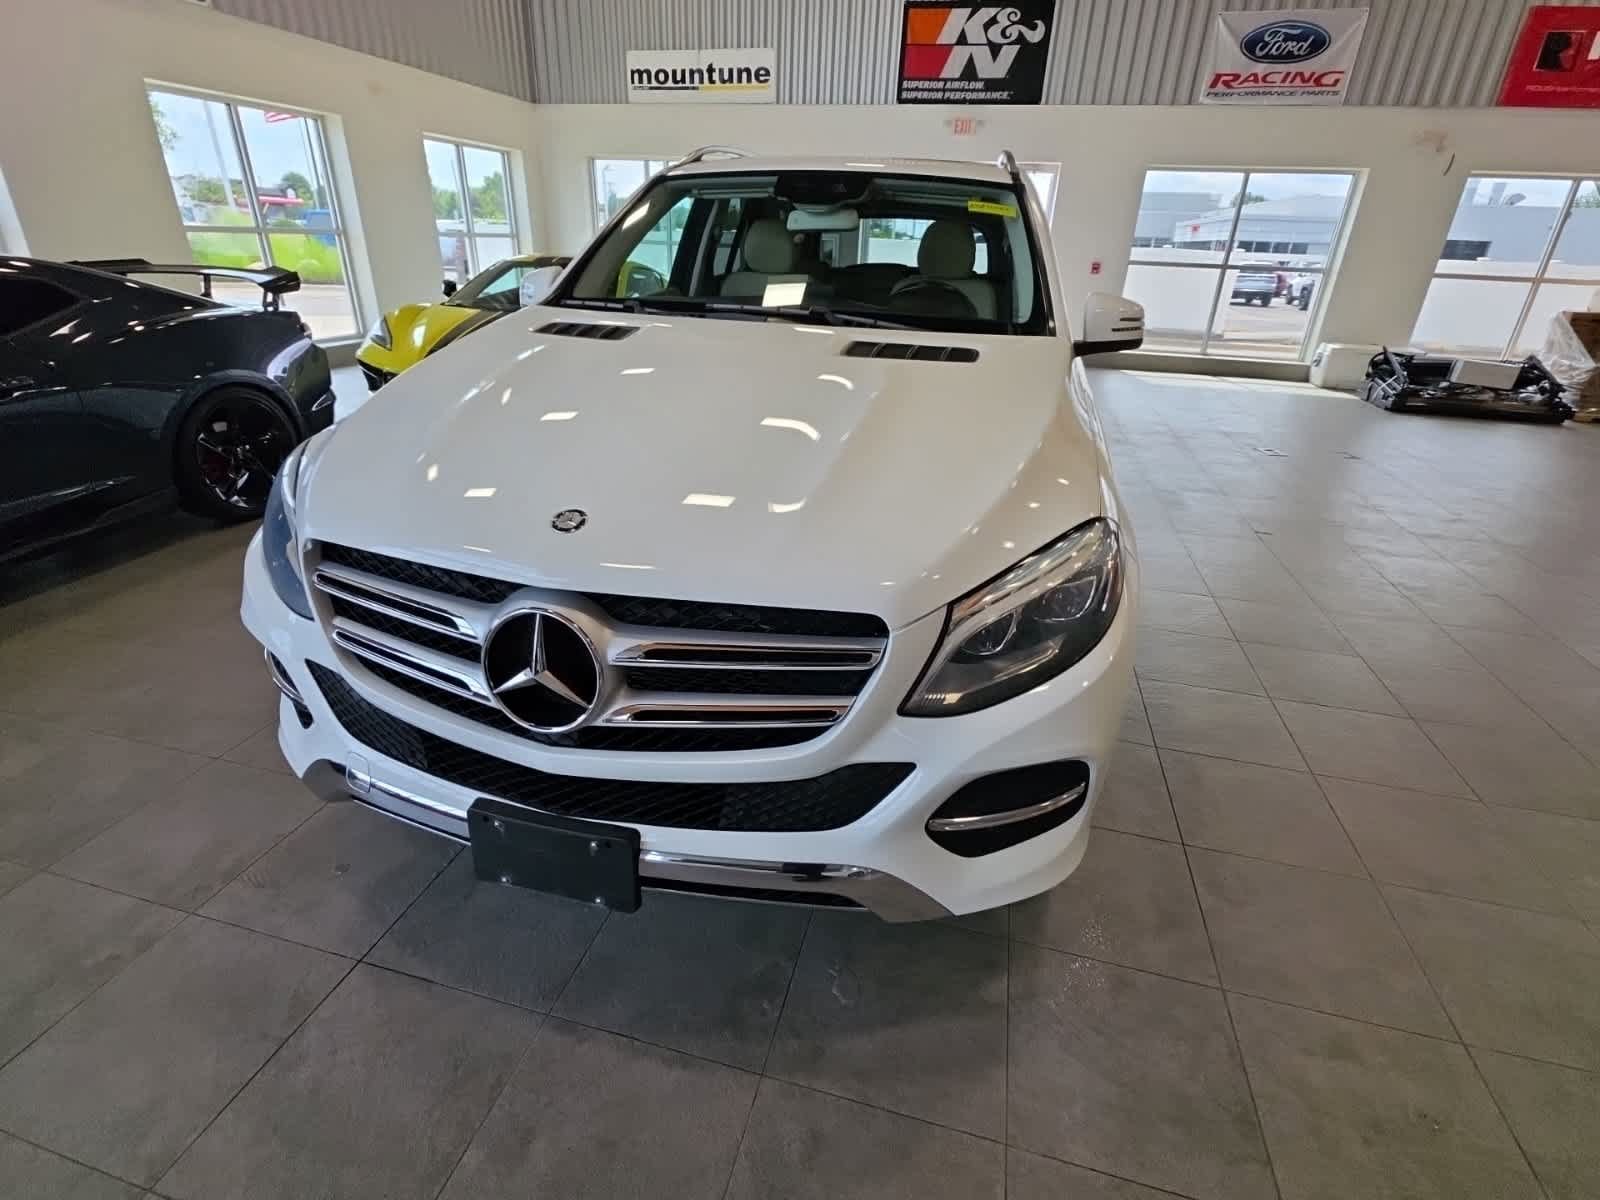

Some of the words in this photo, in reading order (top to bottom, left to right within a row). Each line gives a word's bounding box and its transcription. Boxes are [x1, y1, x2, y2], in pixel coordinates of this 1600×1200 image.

[1255, 27, 1315, 57] Ford
[630, 62, 771, 85] mountune
[1209, 71, 1345, 90] RACING
[902, 81, 944, 90] SUPERIOR
[901, 91, 943, 100] SUPERIOR
